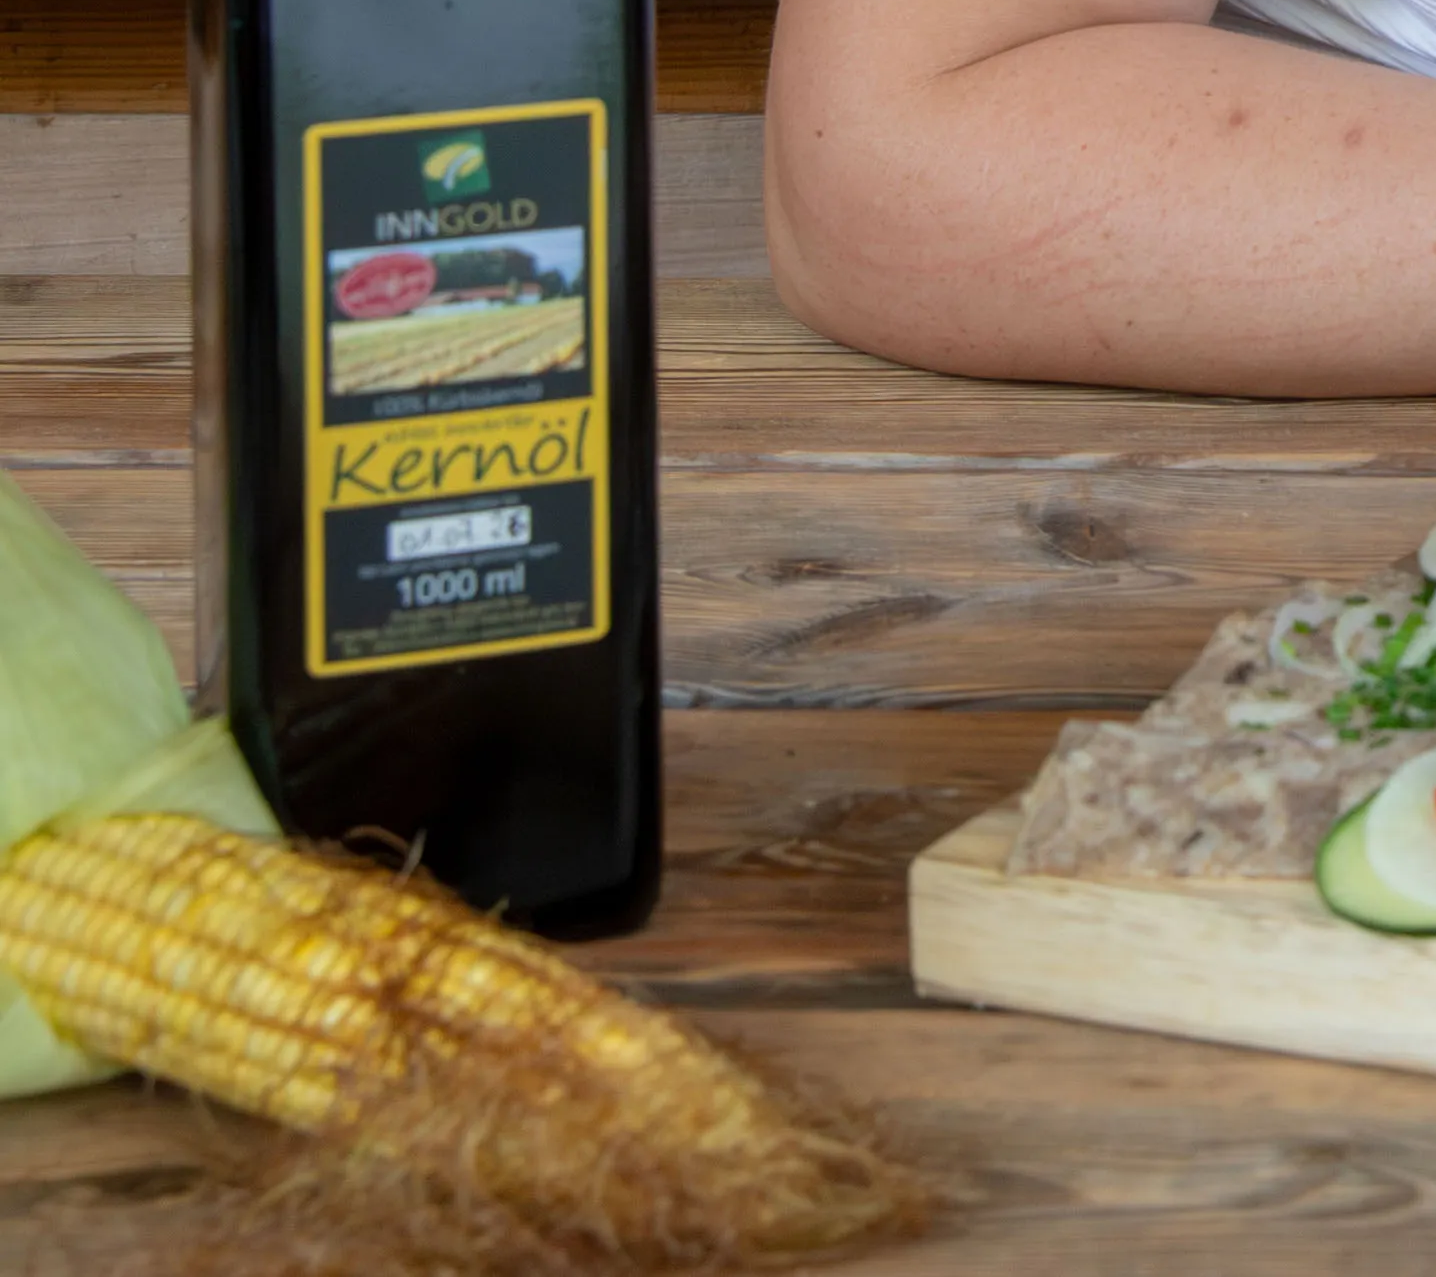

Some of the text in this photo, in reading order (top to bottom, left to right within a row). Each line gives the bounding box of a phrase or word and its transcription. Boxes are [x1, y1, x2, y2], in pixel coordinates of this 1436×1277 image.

[375, 197, 538, 241] INNGOLD
[331, 406, 590, 503] Kernöl
[397, 568, 478, 608] 1000
[484, 561, 526, 596] ml
